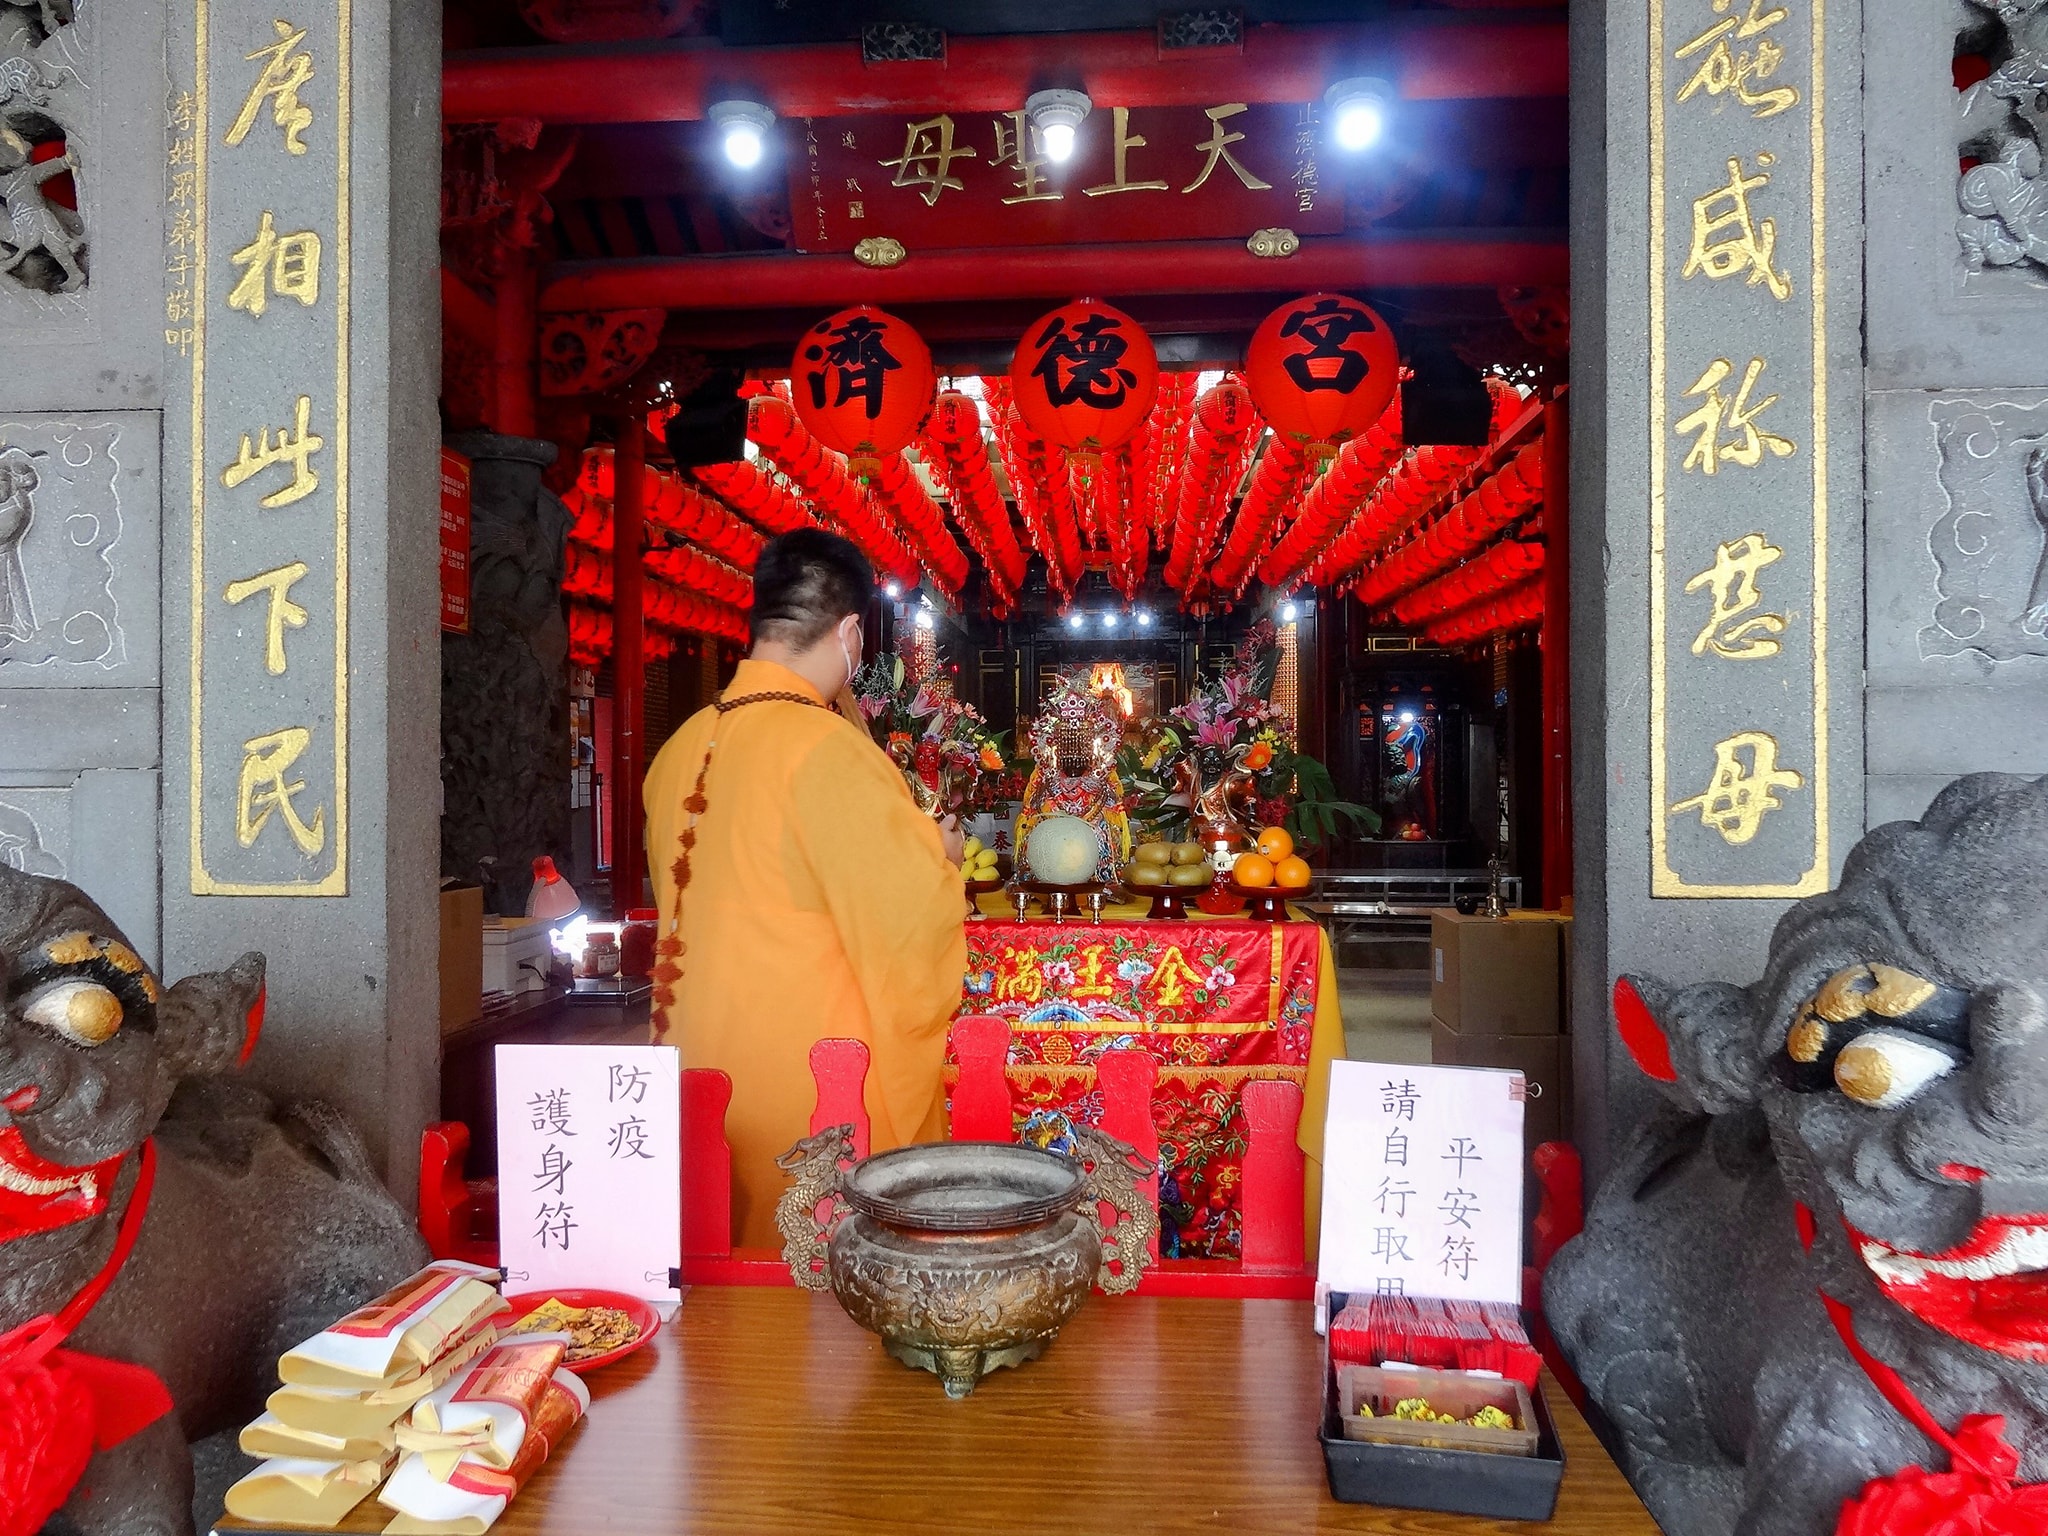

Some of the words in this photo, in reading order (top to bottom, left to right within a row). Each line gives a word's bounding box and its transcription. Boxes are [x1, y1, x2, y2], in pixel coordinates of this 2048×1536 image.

[806, 315, 902, 419] 濟
[1031, 314, 1137, 410] 德
[1280, 300, 1376, 393] 宮
[526, 1087, 579, 1250] 護身符
[607, 1064, 656, 1159] 防疫
[1436, 1137, 1483, 1281] 平安符
